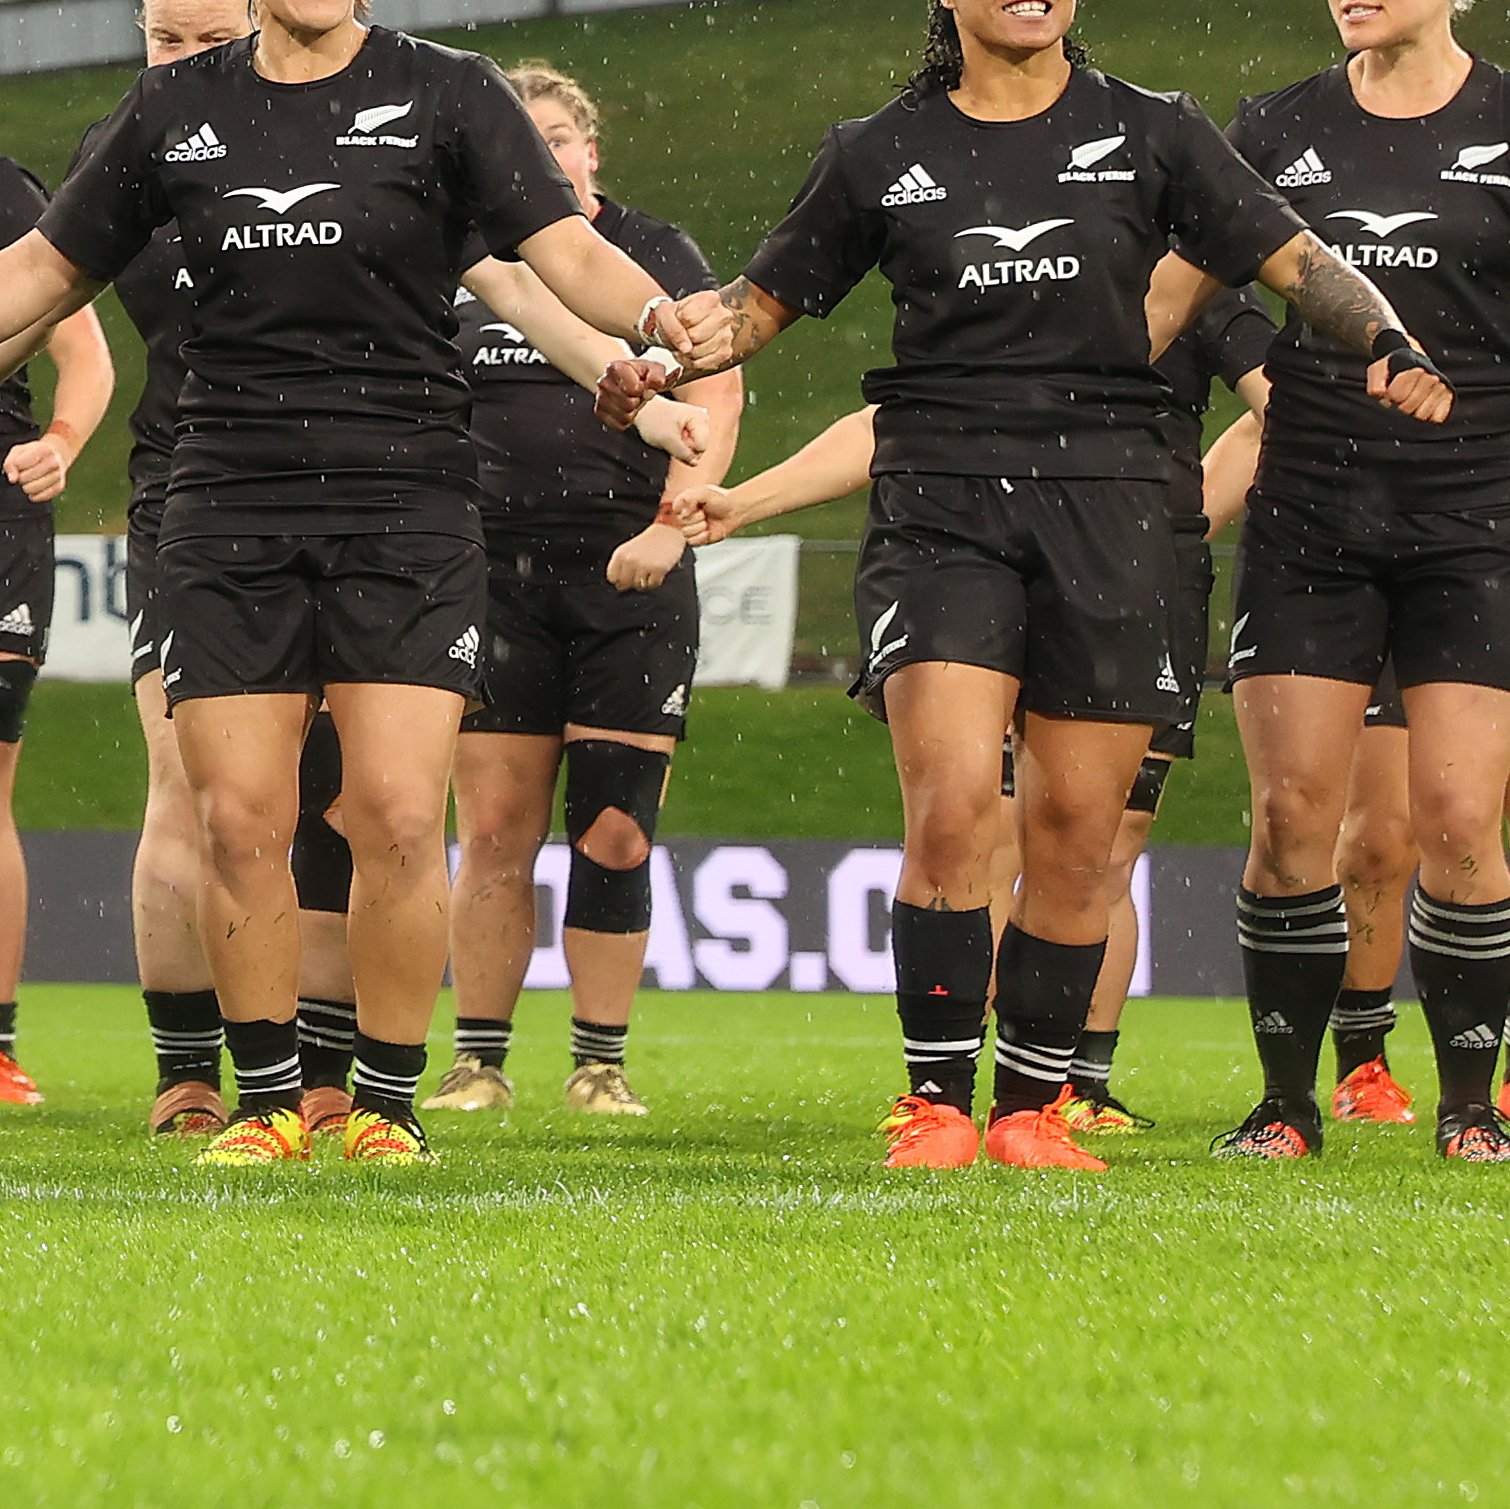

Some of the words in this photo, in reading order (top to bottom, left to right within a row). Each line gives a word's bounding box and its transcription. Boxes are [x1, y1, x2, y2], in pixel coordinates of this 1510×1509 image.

[336, 135, 377, 146] BLACK
[164, 143, 228, 163] adidas
[1058, 171, 1096, 182] BLACK
[1275, 170, 1332, 187] adidas
[1440, 170, 1479, 184] BLACK
[881, 185, 947, 207] adidas
[221, 220, 342, 252] ALTRAD
[958, 254, 1080, 288] ALTRAD
[472, 347, 552, 367] ALTRA
[1449, 1037, 1500, 1050] adidas
